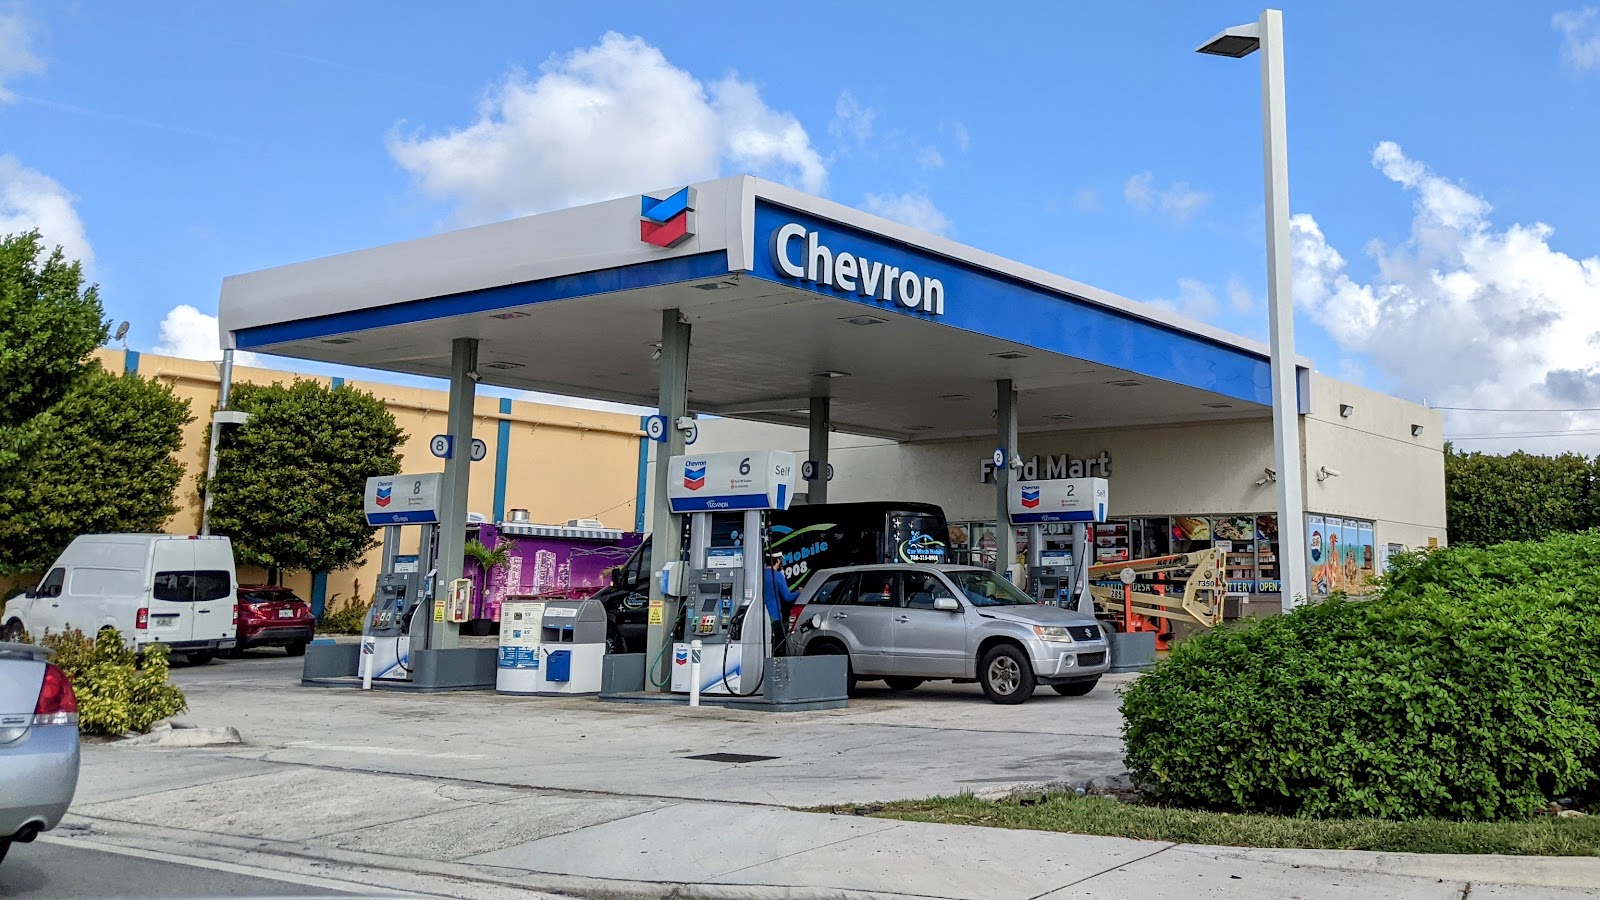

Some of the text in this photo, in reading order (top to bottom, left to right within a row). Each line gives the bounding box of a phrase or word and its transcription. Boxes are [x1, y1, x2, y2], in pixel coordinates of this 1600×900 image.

[772, 222, 944, 315] Chevron
[651, 421, 659, 433] 6
[436, 440, 444, 451] 8
[473, 444, 481, 455] 7
[996, 453, 1001, 462] 2
[739, 457, 750, 475] 6
[775, 465, 791, 476] Self
[805, 465, 810, 473] 4
[980, 451, 1109, 483] Fd Mart
[413, 481, 421, 495] 8
[1066, 484, 1075, 497] 2
[1097, 489, 1106, 498] Self
[782, 541, 829, 566] Mobile
[1197, 580, 1215, 588] T350
[1259, 582, 1278, 592] OPEN
[1110, 589, 1123, 599] 285
